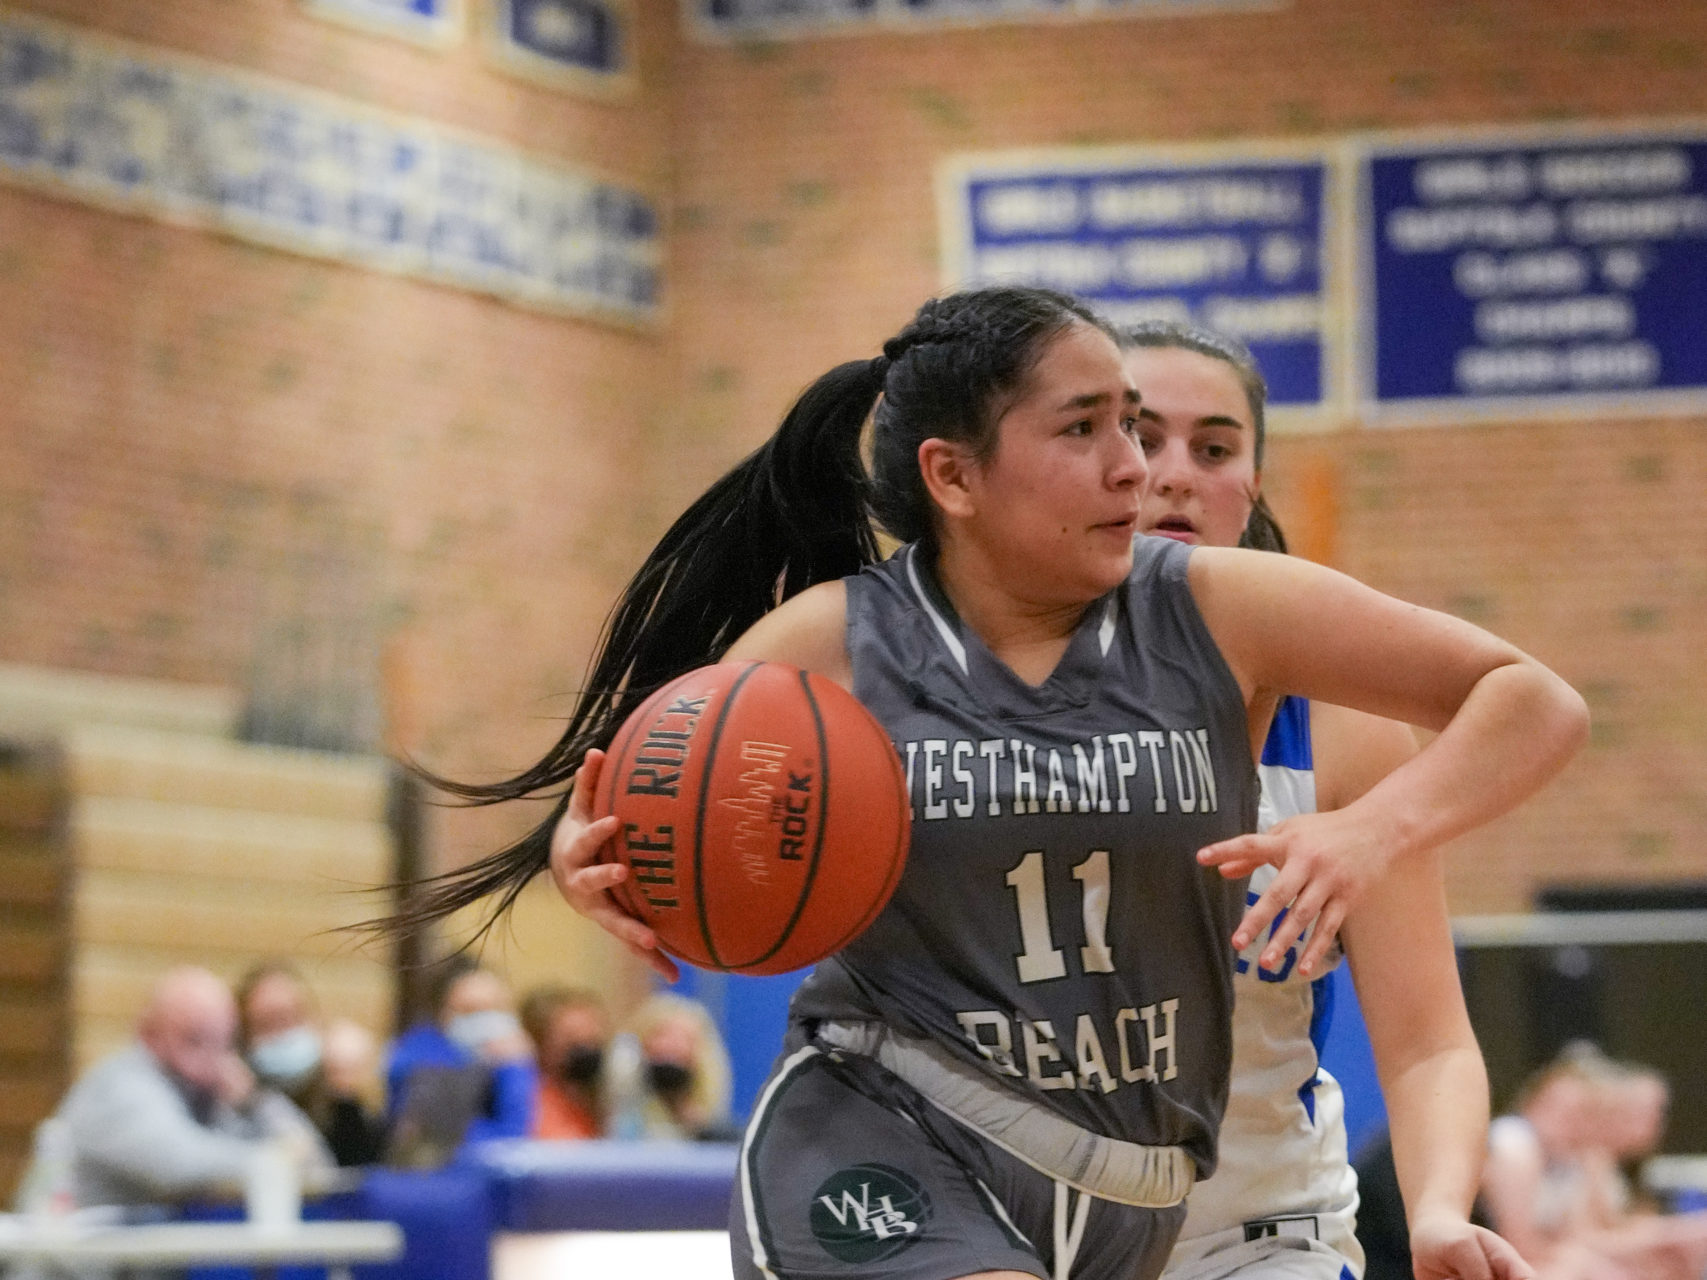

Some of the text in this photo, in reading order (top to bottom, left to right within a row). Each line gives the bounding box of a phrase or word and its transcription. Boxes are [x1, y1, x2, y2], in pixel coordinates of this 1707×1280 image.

[625, 695, 711, 915] THE ROCK
[780, 770, 812, 860] ROCK
[1005, 849, 1116, 984] 11
[955, 997, 1180, 1095] BEACH
